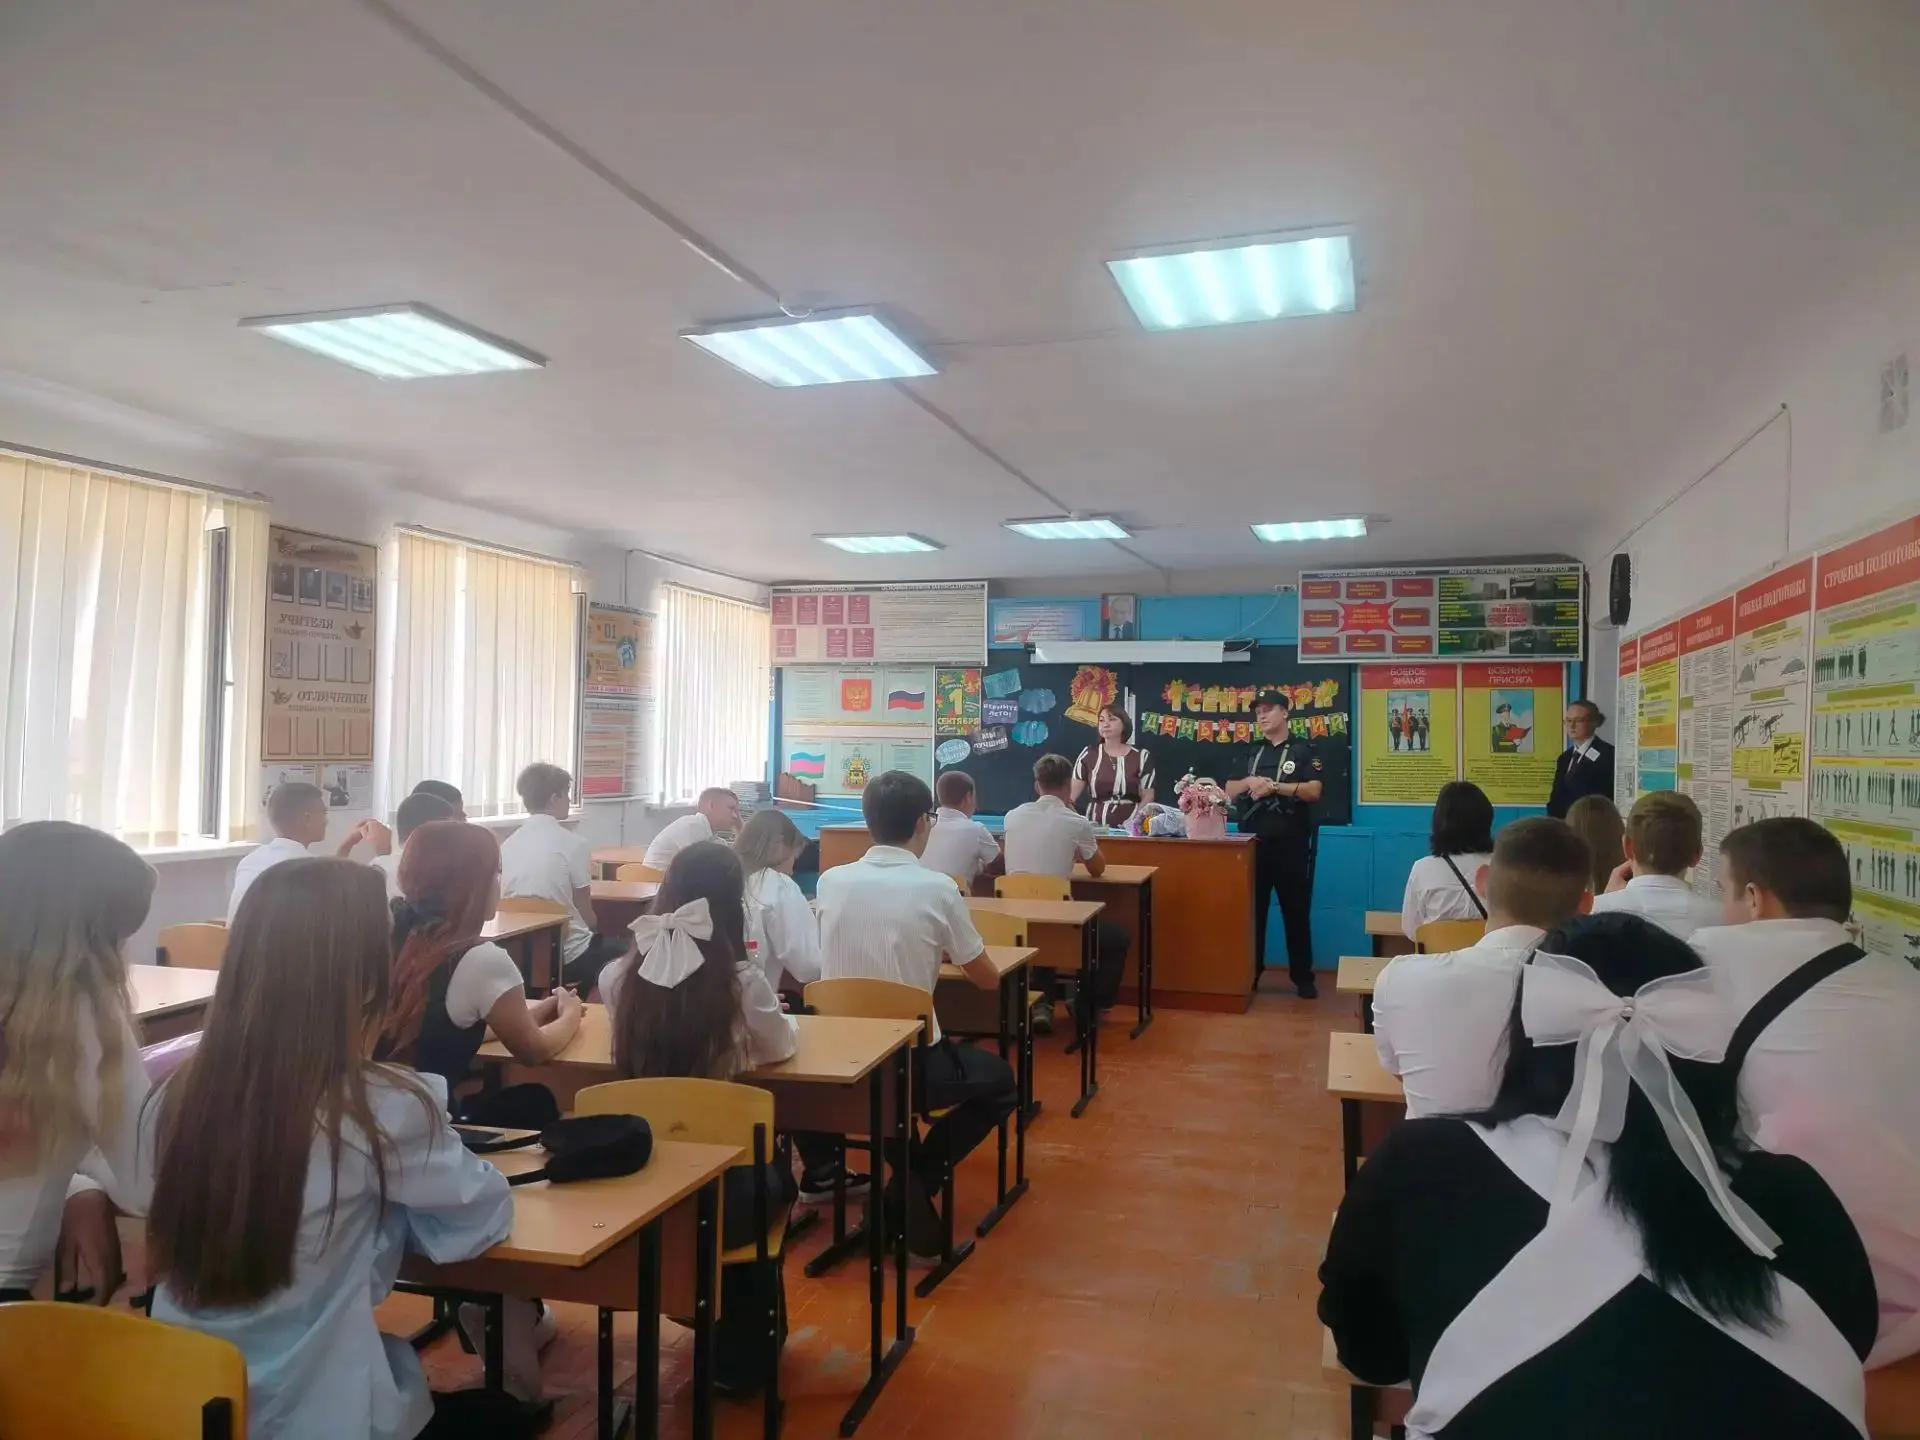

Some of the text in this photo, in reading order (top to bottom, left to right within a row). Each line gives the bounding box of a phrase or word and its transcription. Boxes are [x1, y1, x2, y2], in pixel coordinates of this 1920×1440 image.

[1390, 667, 1427, 676] БОЕВОЕ
[1392, 676, 1425, 685] ЗНАМЯ
[1489, 675, 1533, 685] ПРИСЯГА
[949, 687, 963, 715] 1
[1143, 713, 1212, 740] ДЕНЬ
[981, 731, 996, 740] МЫ
